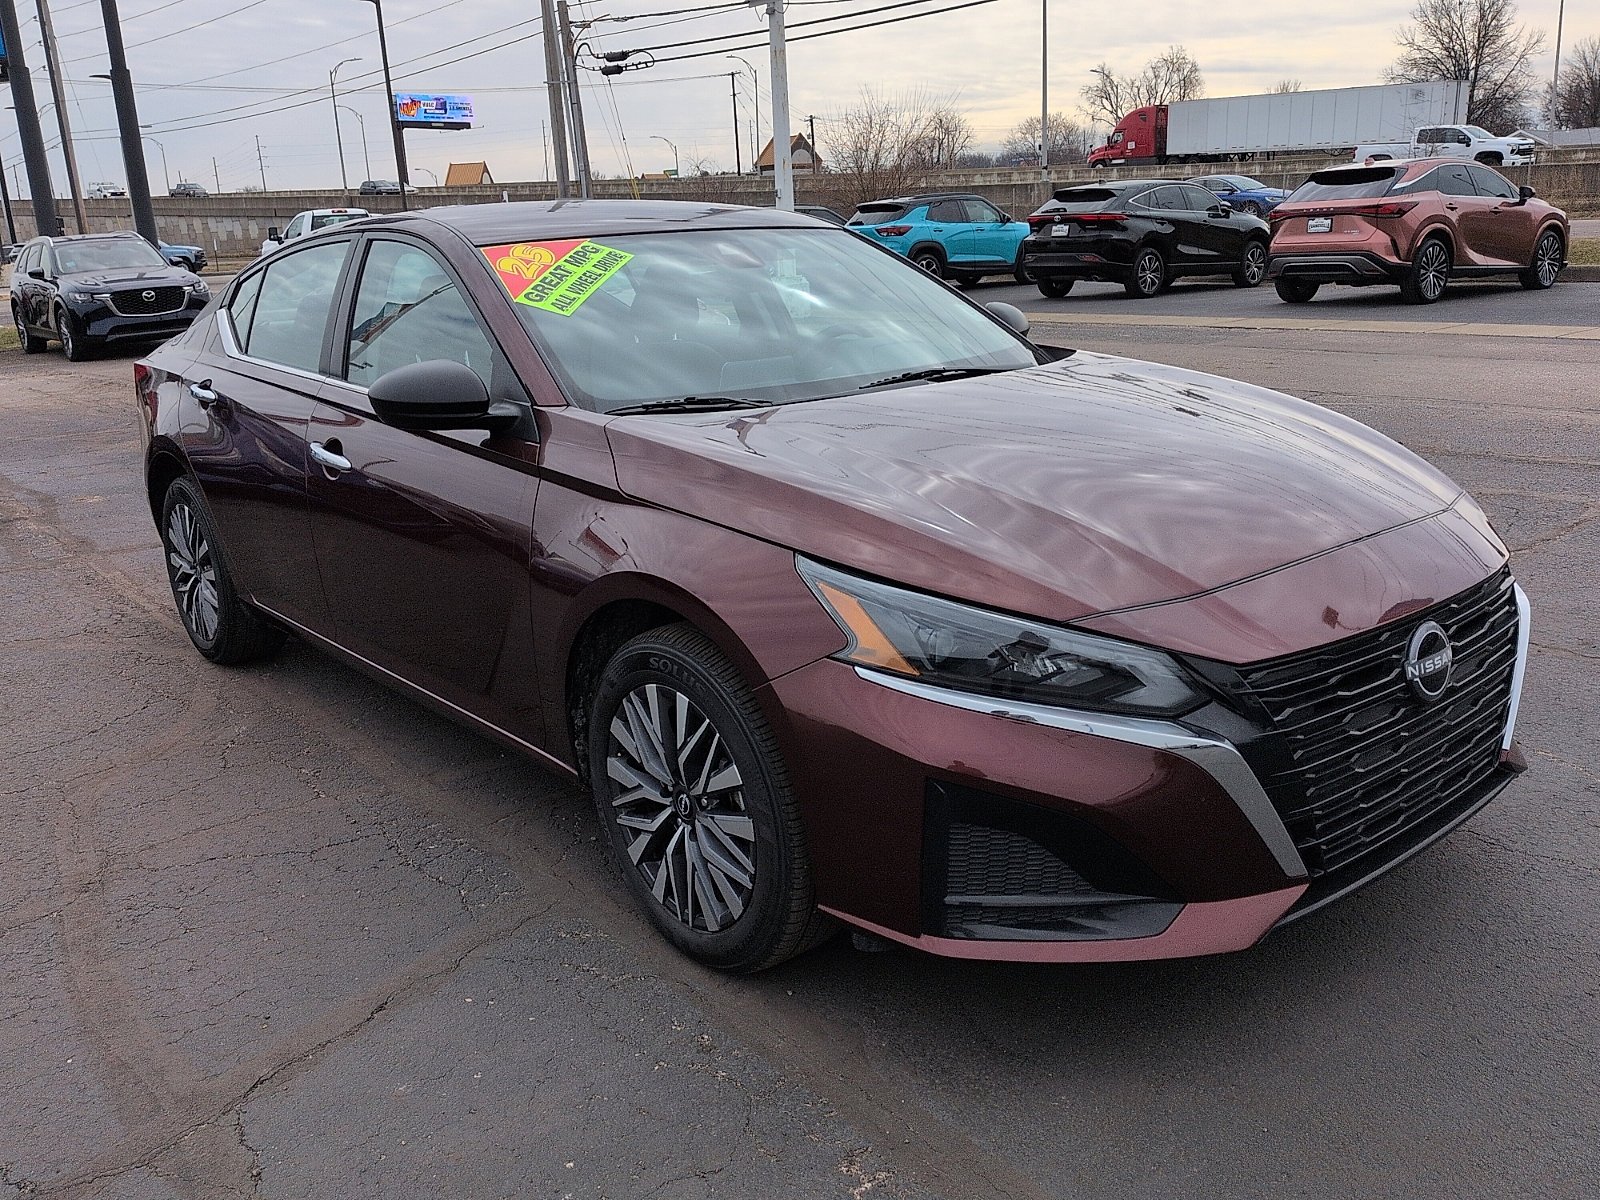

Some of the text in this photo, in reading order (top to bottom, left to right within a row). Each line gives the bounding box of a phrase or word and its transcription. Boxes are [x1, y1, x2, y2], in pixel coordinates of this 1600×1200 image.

[496, 244, 555, 280] 25
[523, 244, 601, 302] GREAT MPG
[551, 250, 624, 312] ALL WHEEL DRIVE
